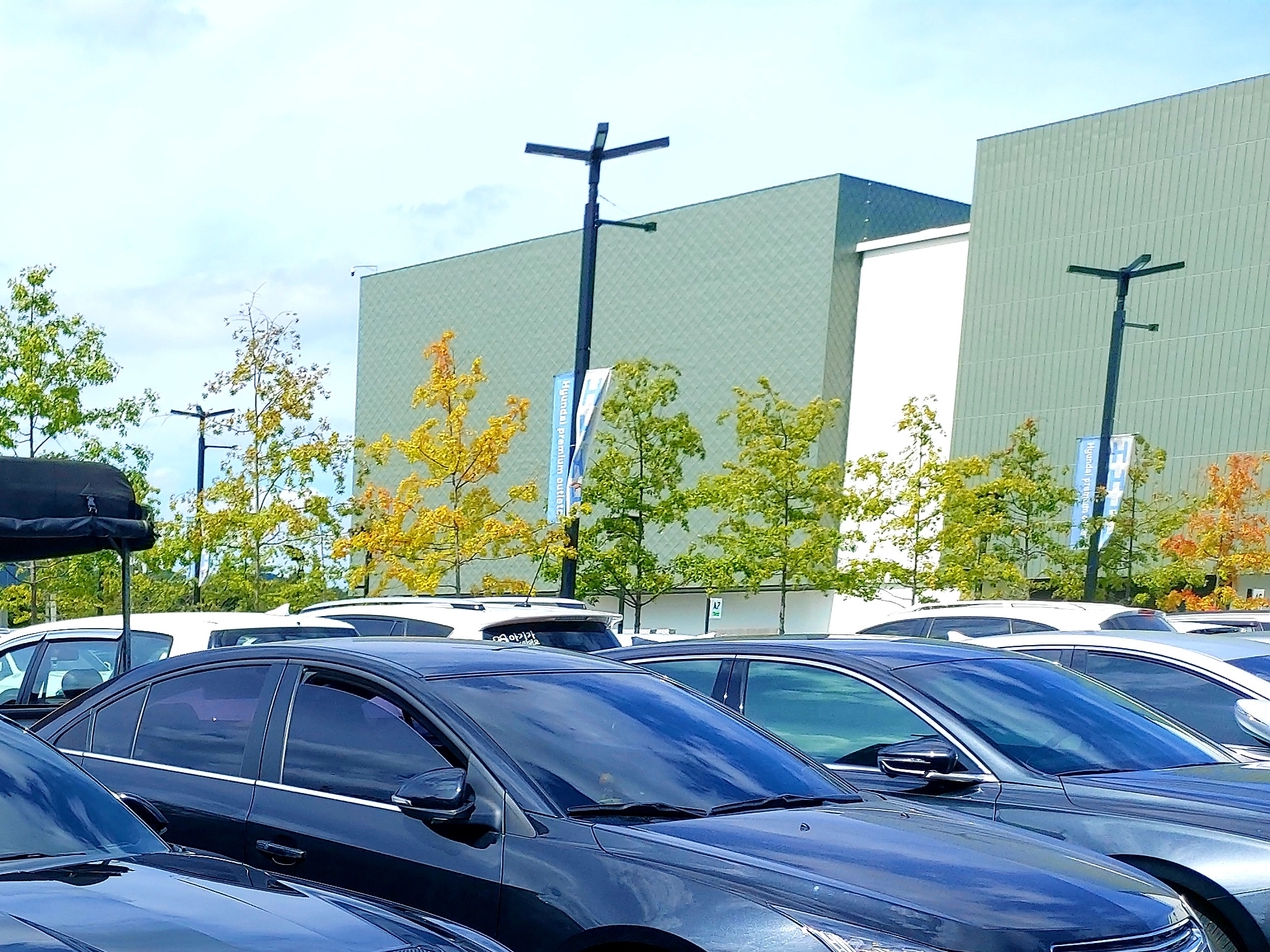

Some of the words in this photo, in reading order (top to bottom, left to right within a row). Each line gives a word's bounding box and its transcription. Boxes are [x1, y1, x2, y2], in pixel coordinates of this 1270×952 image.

[558, 380, 571, 425] Hyundai
[556, 427, 566, 475] premium
[1084, 442, 1096, 477] Hyundai
